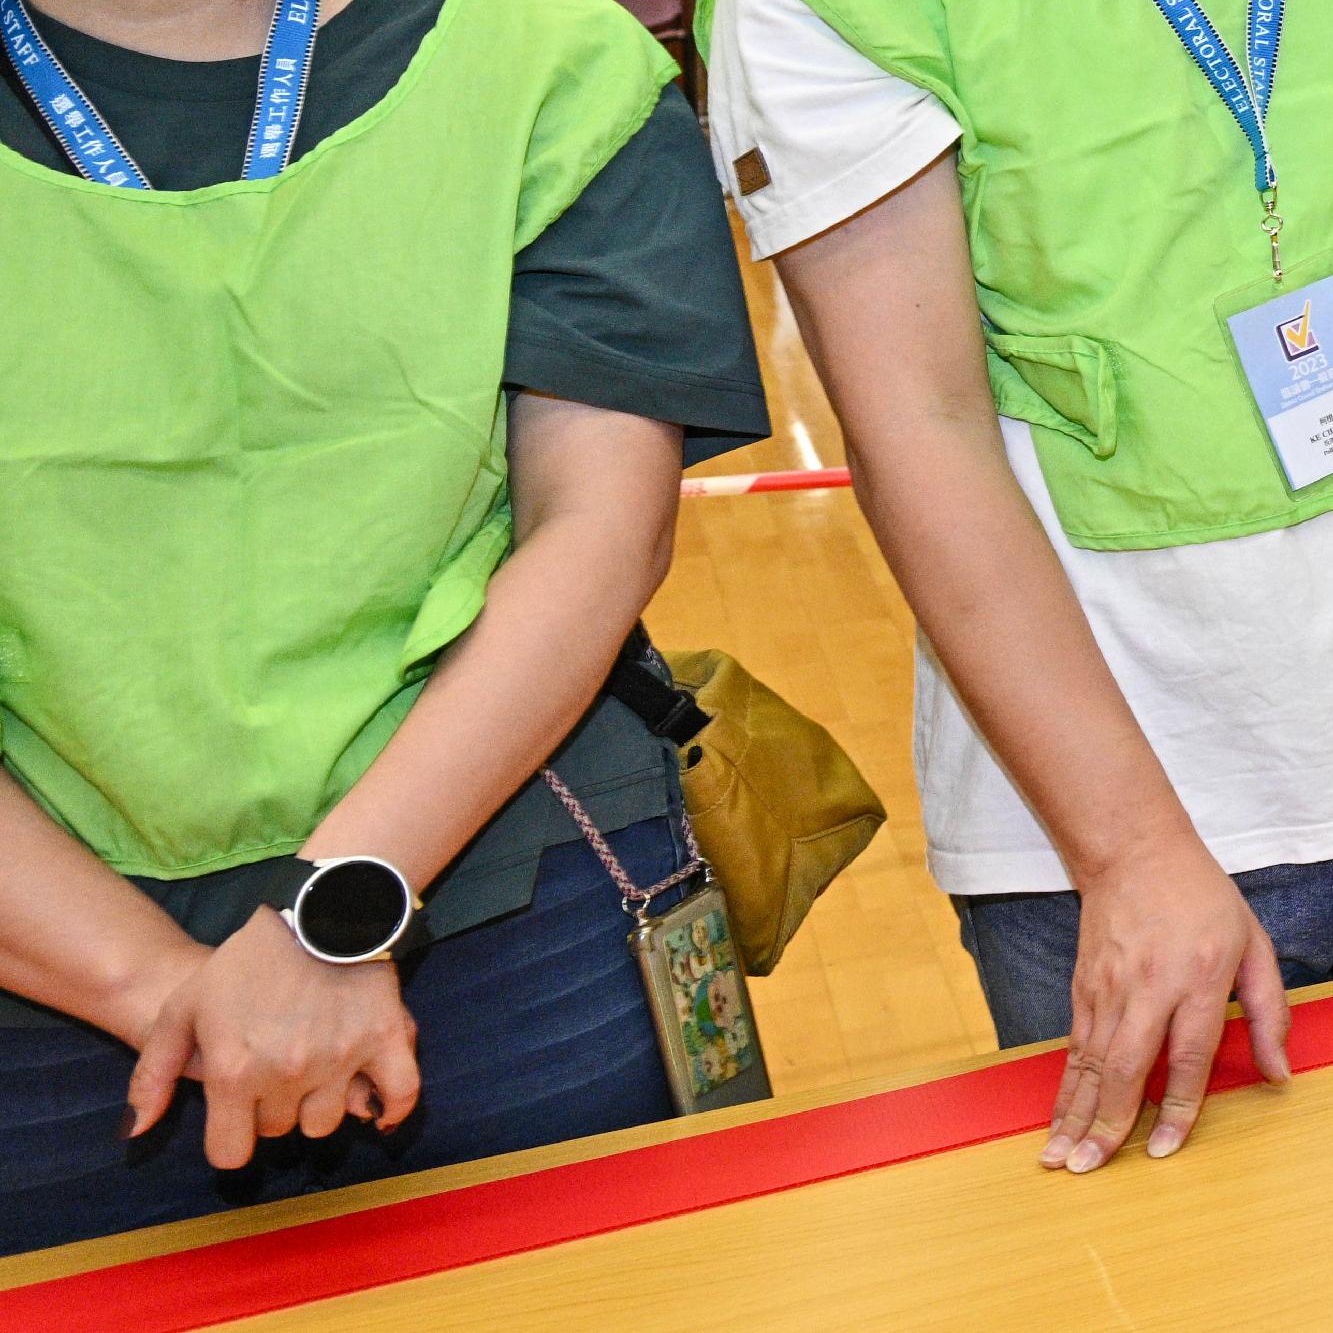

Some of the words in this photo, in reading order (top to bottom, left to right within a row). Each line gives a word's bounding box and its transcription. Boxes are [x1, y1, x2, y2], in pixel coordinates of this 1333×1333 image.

[3, 10, 40, 67] STAFF
[1178, 7, 1250, 114] ELECTORAL
[49, 93, 129, 186] 選舉工作人員
[258, 58, 298, 159] 選舉工作人員
[1288, 353, 1328, 381] 2023
[1310, 430, 1321, 443] KE
